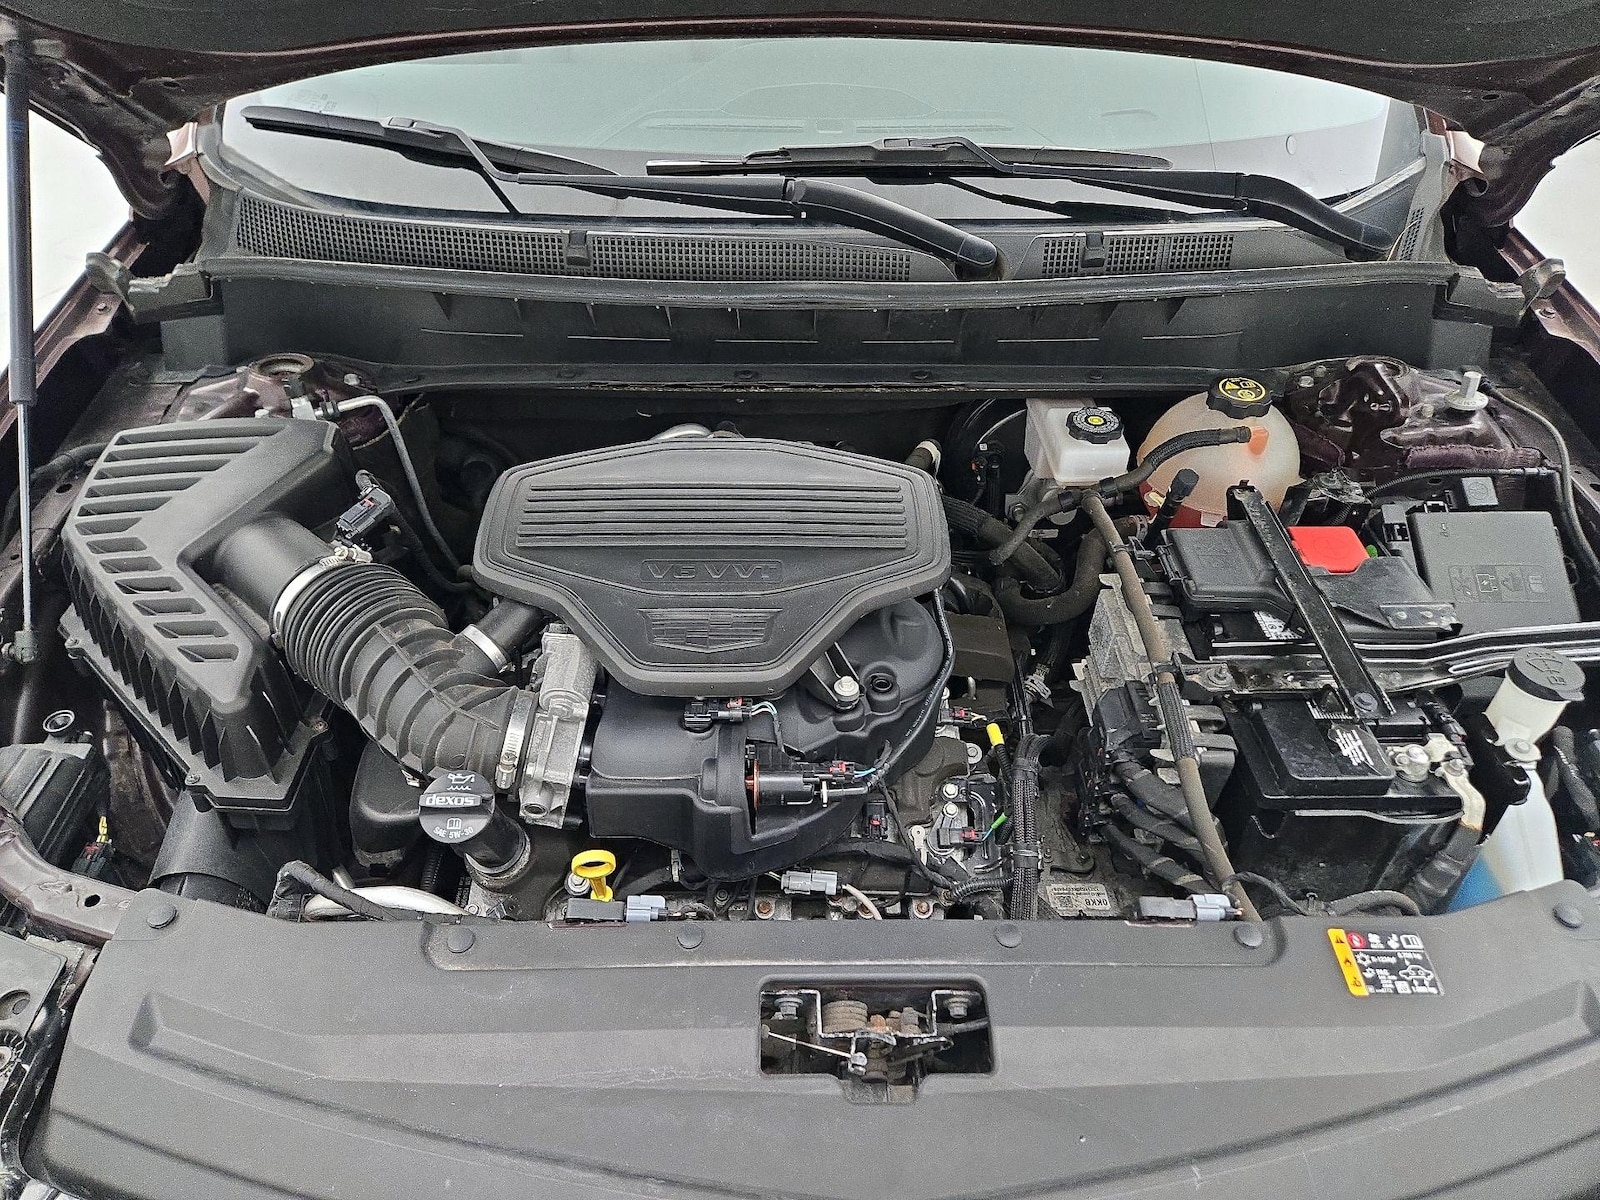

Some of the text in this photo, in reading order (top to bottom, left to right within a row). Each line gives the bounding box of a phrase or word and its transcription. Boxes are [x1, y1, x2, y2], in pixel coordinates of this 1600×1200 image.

[426, 794, 474, 806] dexos
[433, 826, 473, 839] SAE 5W-30
